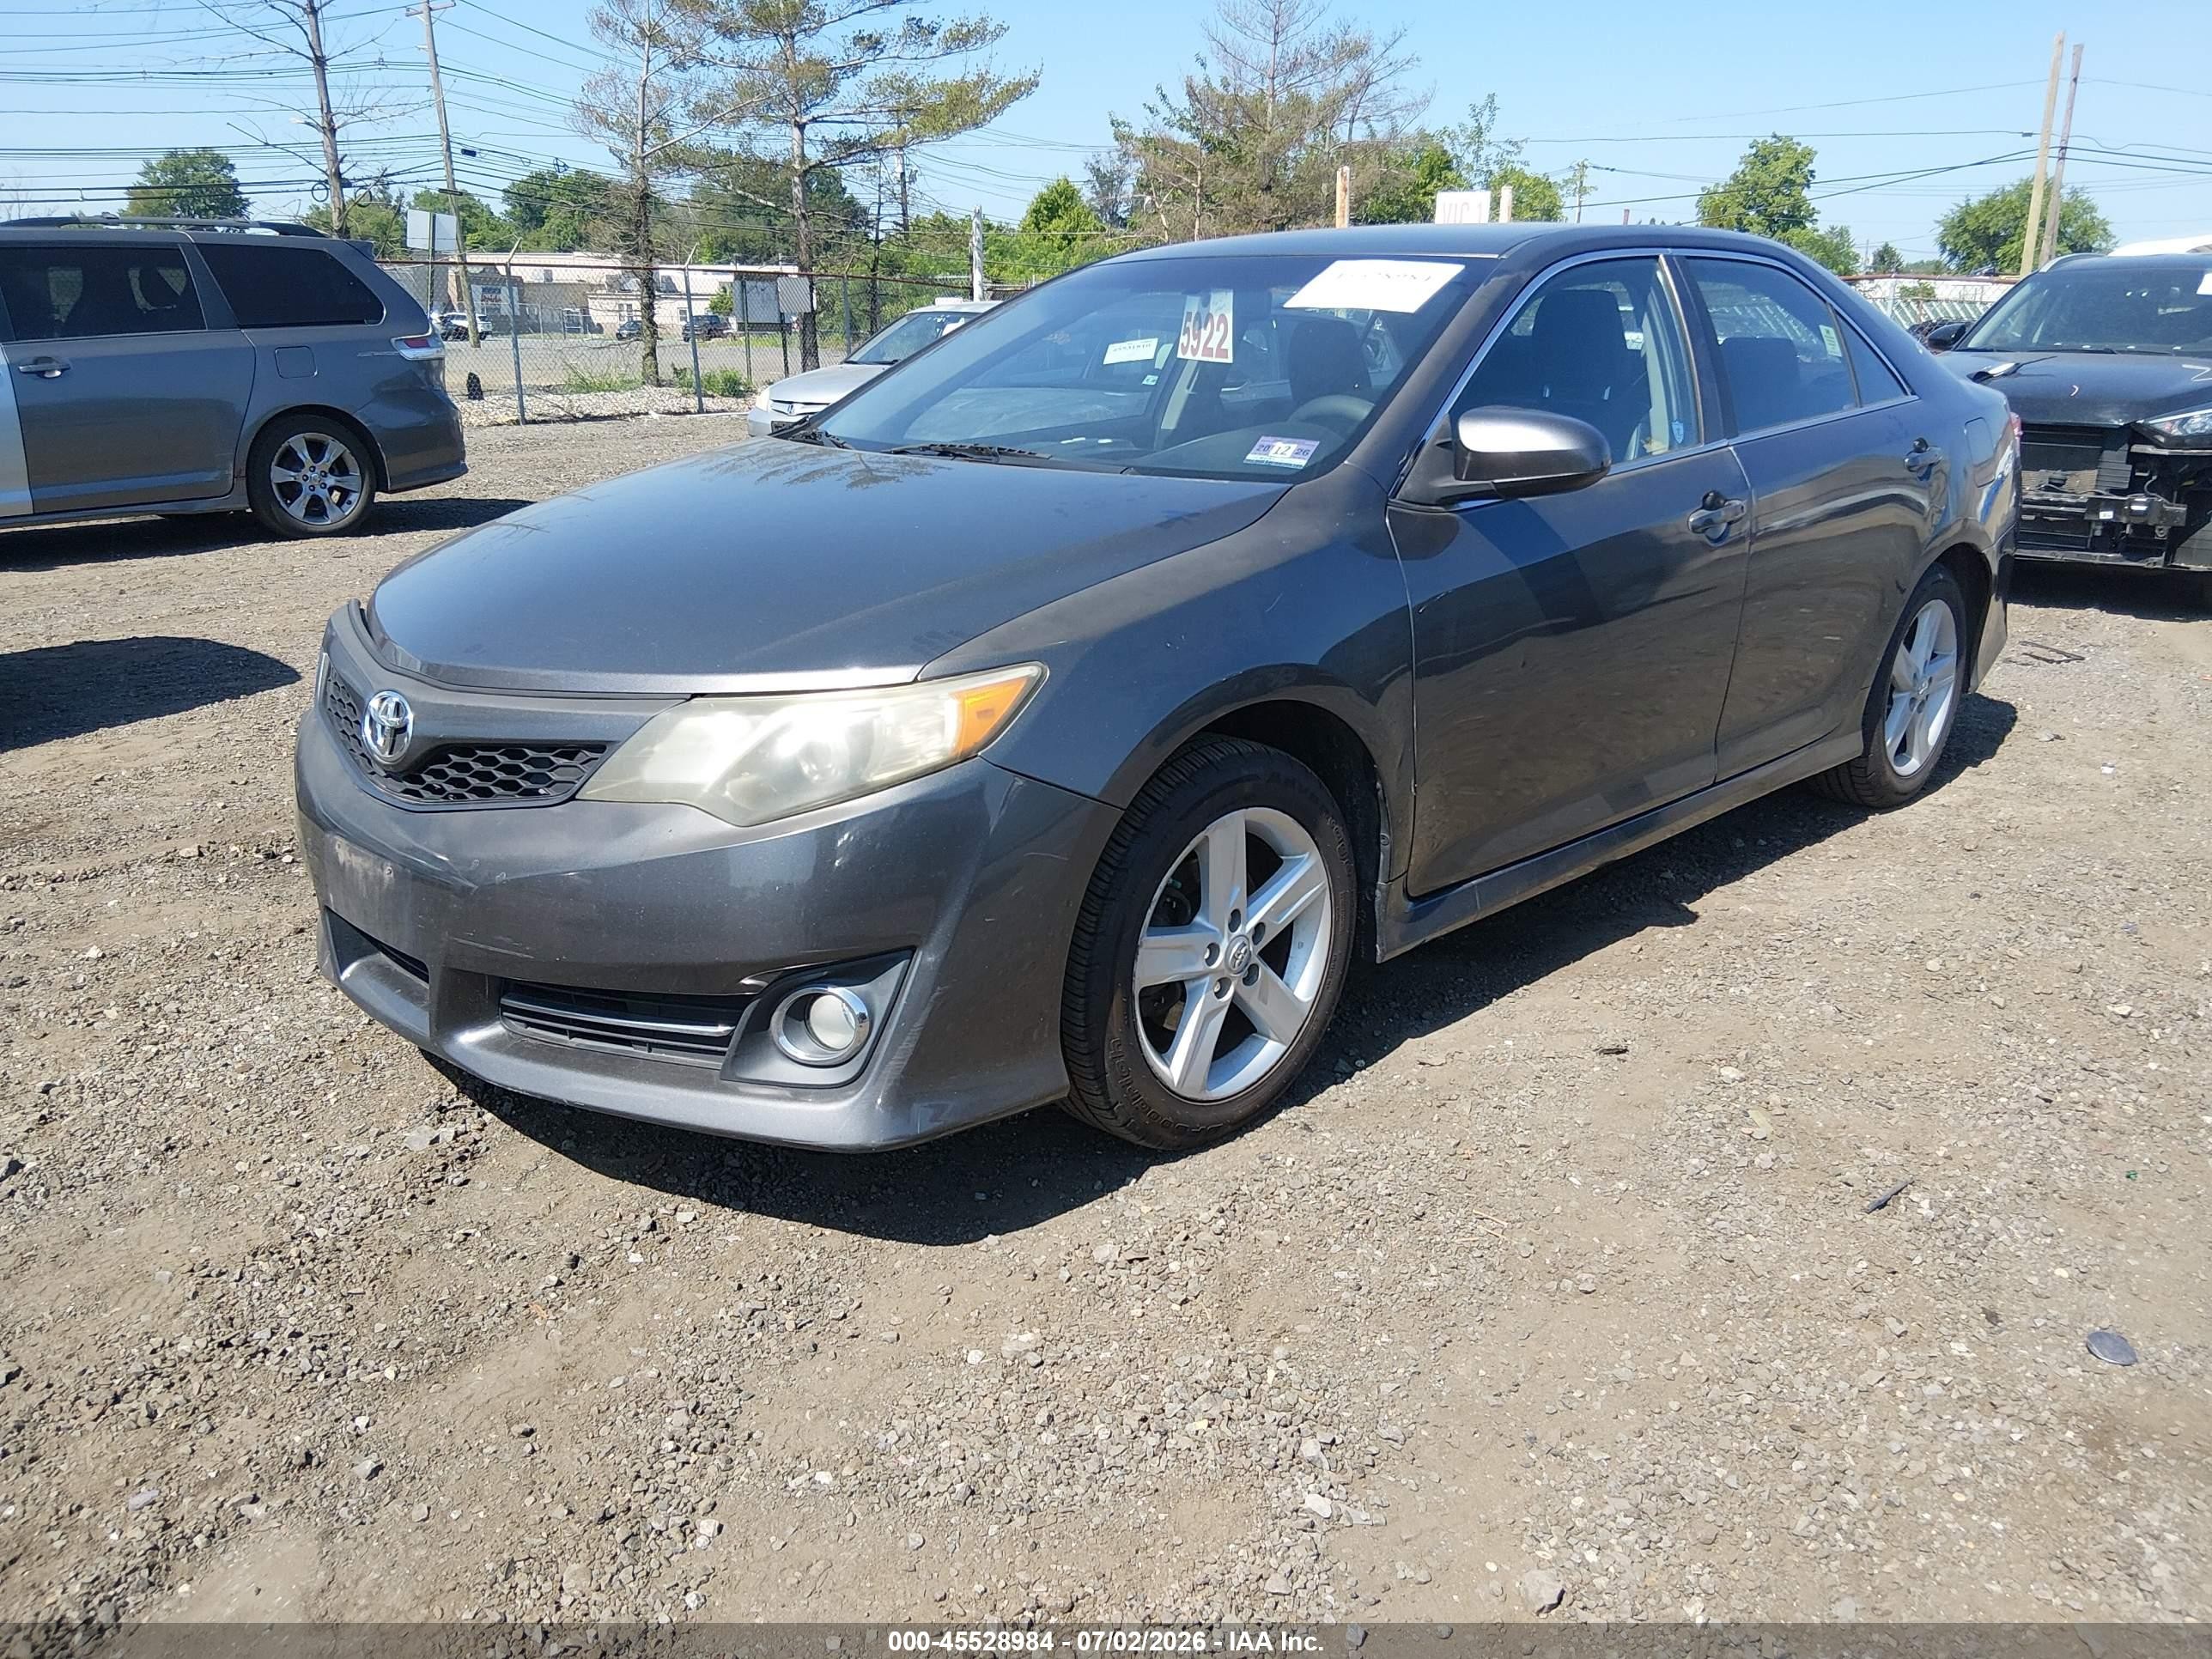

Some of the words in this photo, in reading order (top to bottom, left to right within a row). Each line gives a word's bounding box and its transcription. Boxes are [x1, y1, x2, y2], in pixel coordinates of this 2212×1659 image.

[1181, 311, 1229, 358] 5922
[1273, 445, 1290, 455] 12
[1295, 447, 1310, 456] 26
